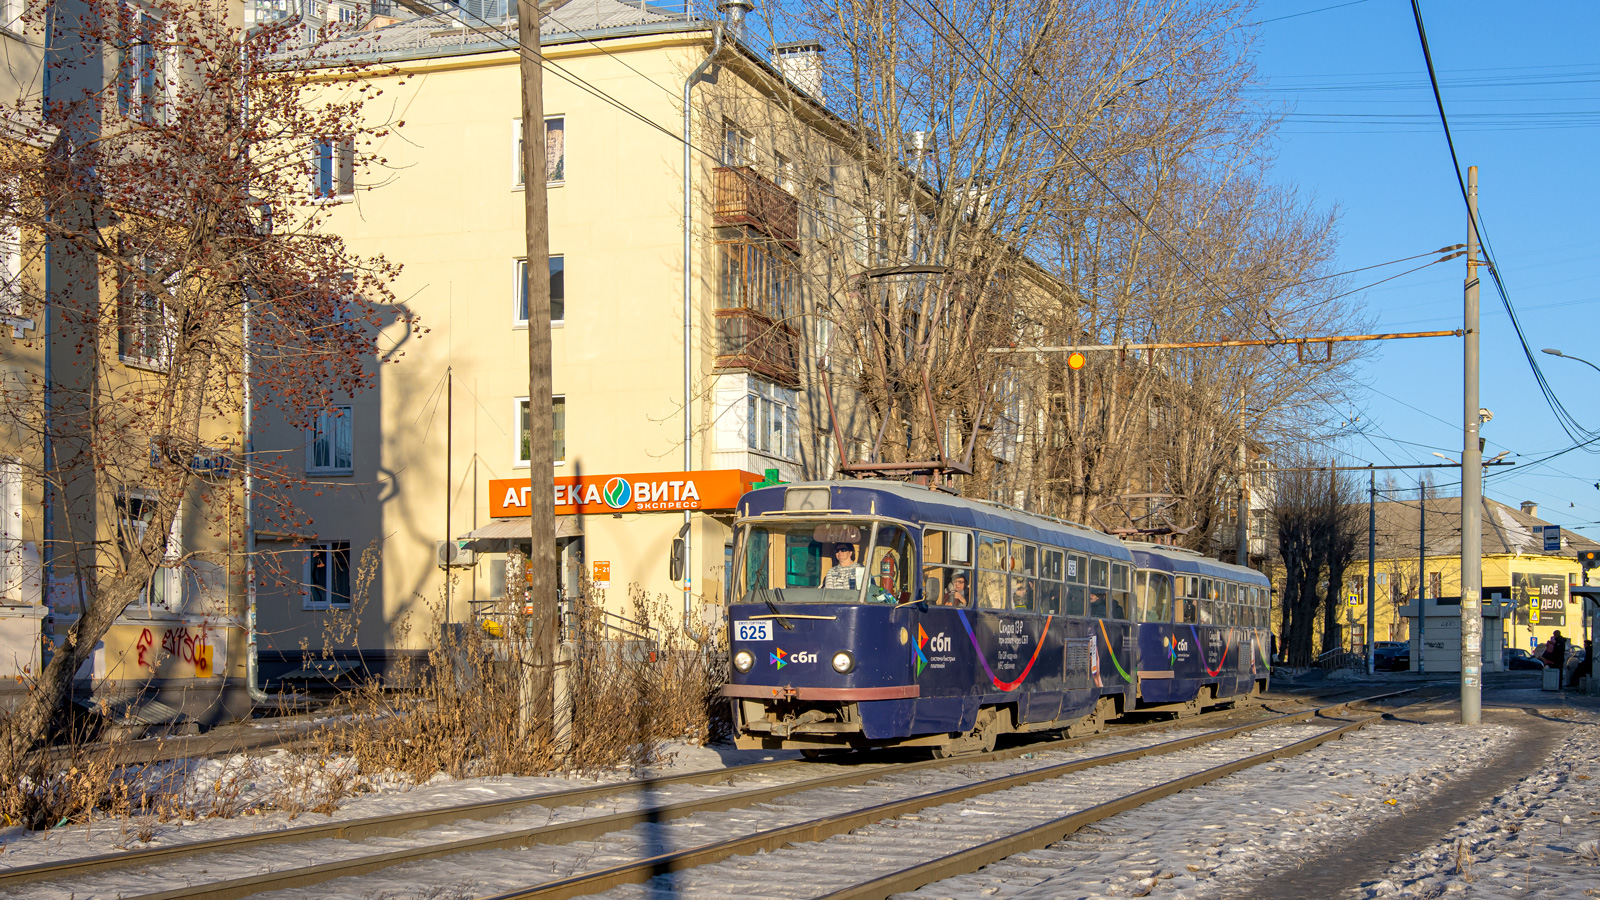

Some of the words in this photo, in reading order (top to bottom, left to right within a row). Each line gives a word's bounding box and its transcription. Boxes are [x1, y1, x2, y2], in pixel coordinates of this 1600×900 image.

[503, 484, 602, 508] АПЕКА
[634, 481, 700, 502] ВИТА
[637, 501, 698, 509] ЭКСПРЕСС
[1541, 583, 1559, 595] МОЁ
[1540, 599, 1563, 610] ДЕЛО
[740, 626, 766, 640] 625
[930, 632, 952, 652] сбп
[790, 651, 817, 663] сбп
